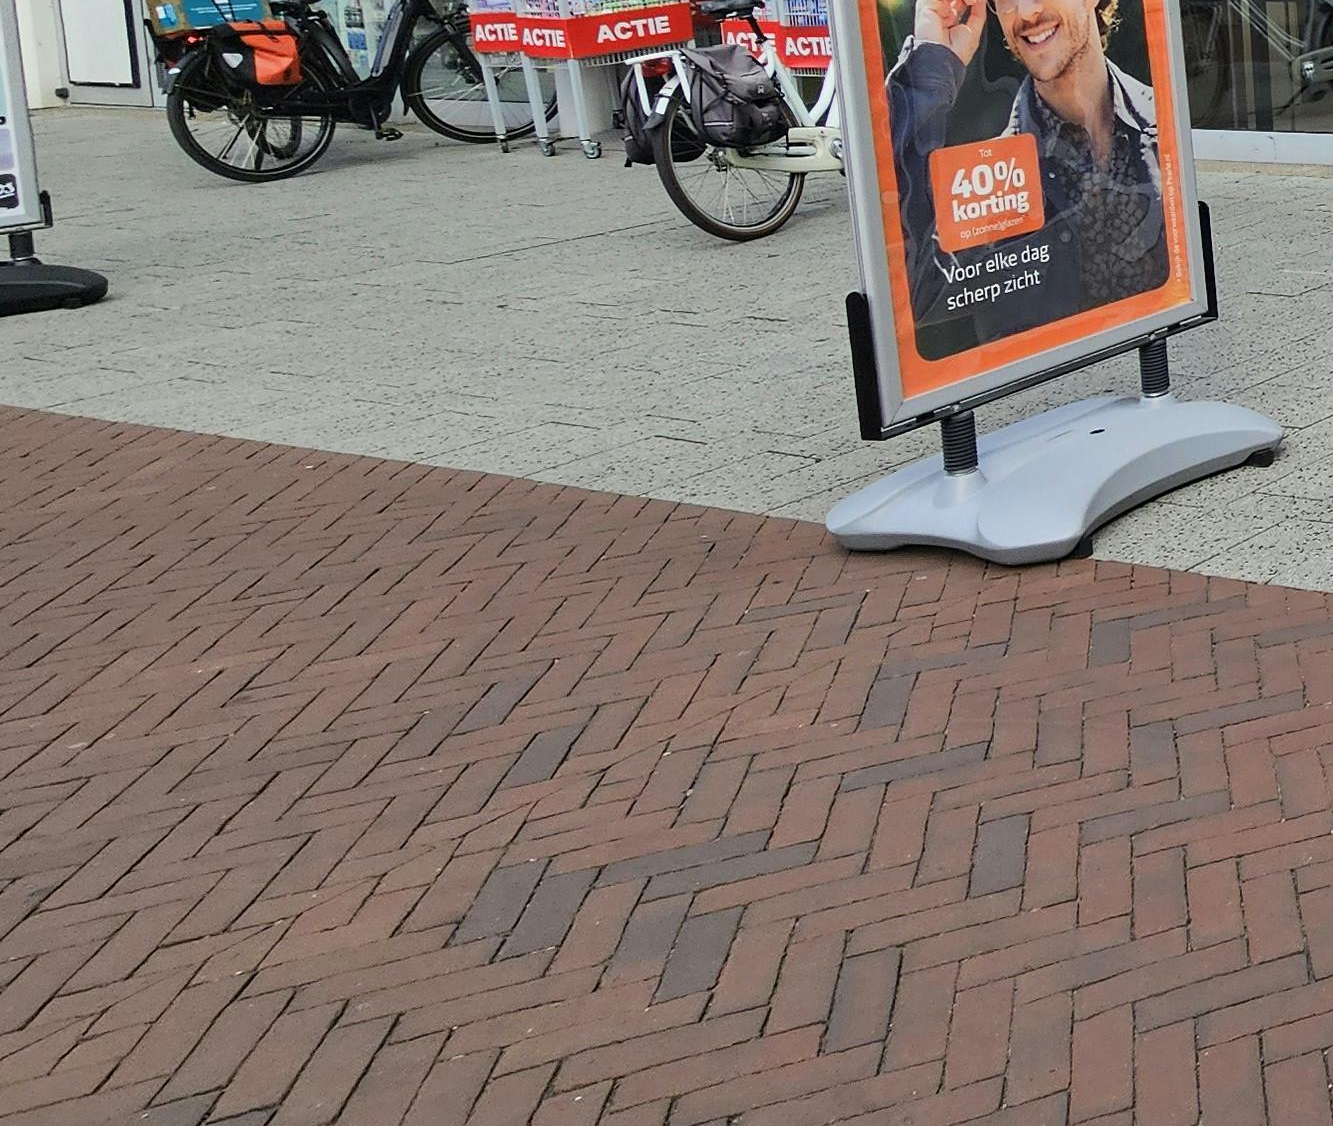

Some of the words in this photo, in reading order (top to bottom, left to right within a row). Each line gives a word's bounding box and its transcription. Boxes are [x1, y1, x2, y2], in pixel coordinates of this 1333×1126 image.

[475, 23, 519, 42] ACTIE
[522, 27, 567, 47] ACTIE
[597, 15, 671, 43] ACTIE
[726, 32, 776, 52] ACTE
[978, 148, 992, 158] Tot
[951, 157, 1026, 199] 40%
[952, 190, 1029, 223] korting
[943, 261, 982, 284] Voor
[985, 253, 1018, 275] elke
[1021, 242, 1050, 264] dag
[946, 284, 1001, 311] scherp
[1004, 269, 1041, 294] zicht
